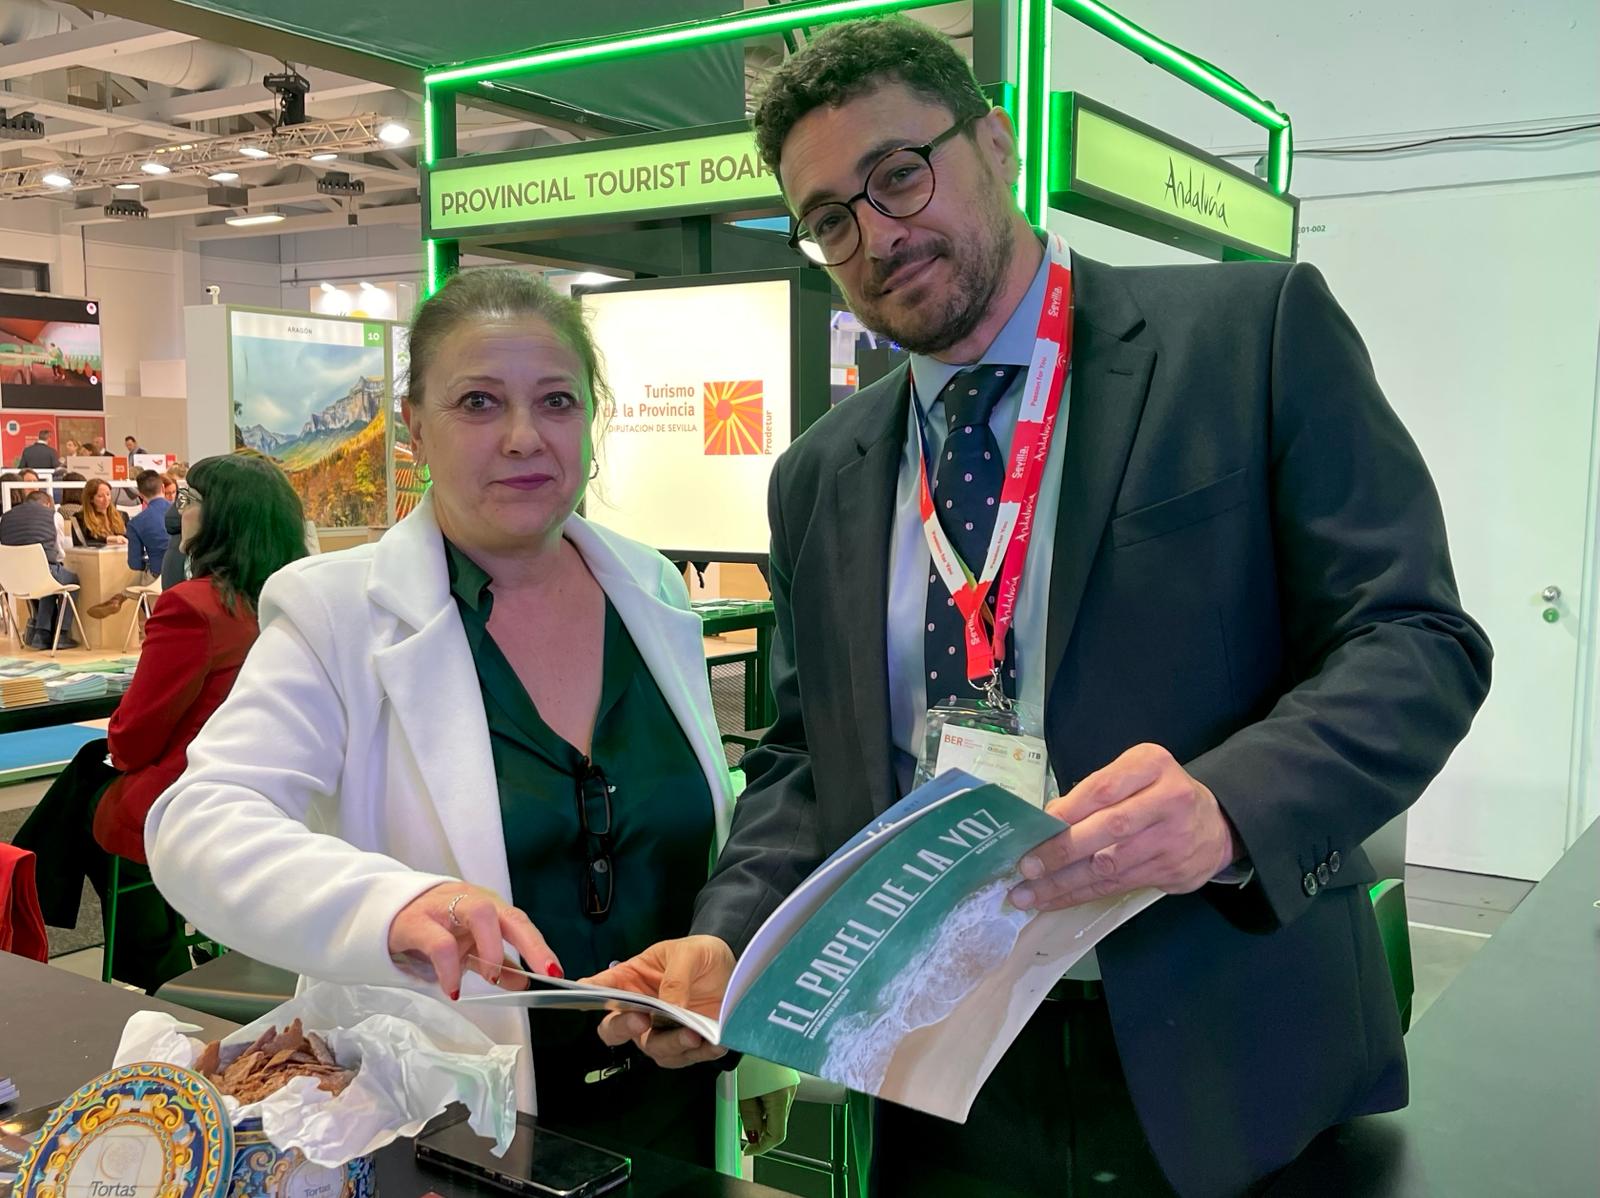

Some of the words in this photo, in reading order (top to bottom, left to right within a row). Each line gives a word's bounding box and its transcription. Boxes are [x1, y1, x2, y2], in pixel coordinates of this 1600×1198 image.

[441, 176, 575, 216] PROVINCIAL
[584, 161, 691, 198] TOURIST
[700, 153, 774, 185] BOAR
[1164, 156, 1229, 229] Andalucía
[367, 332, 380, 341] 10
[644, 384, 695, 399] Turismo
[623, 403, 634, 418] la
[639, 401, 695, 417] Provincia
[656, 423, 666, 432] DE
[668, 422, 698, 432] SEVILLA
[764, 410, 773, 455] Prodetur
[944, 734, 964, 746] BER
[1028, 751, 1041, 760] ITB
[768, 1000, 820, 1033] EL
[795, 919, 886, 998] PAPEL
[866, 878, 921, 919] DE
[902, 848, 954, 883] LA
[938, 808, 1010, 850] VOZ
[91, 1181, 137, 1197] Tortas
